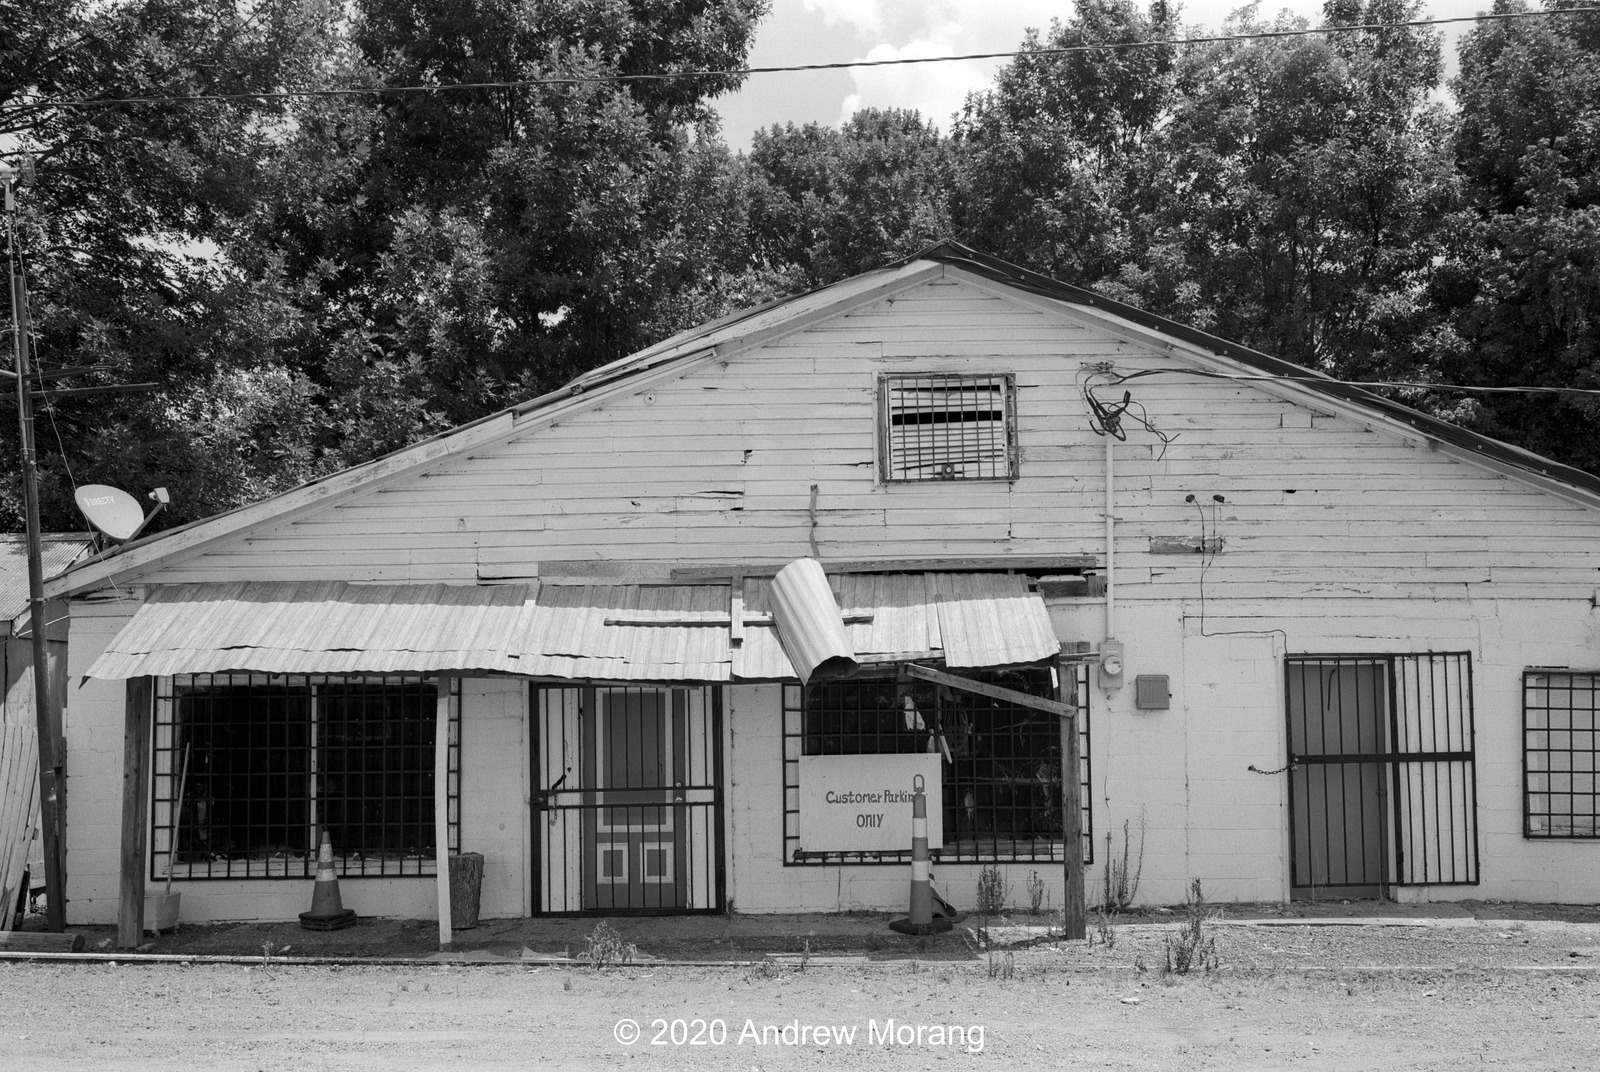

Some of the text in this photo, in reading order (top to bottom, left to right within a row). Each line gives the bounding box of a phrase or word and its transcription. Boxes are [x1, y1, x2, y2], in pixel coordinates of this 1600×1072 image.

[88, 495, 115, 506] DIRECTV
[826, 789, 920, 804] Customer Parkin
